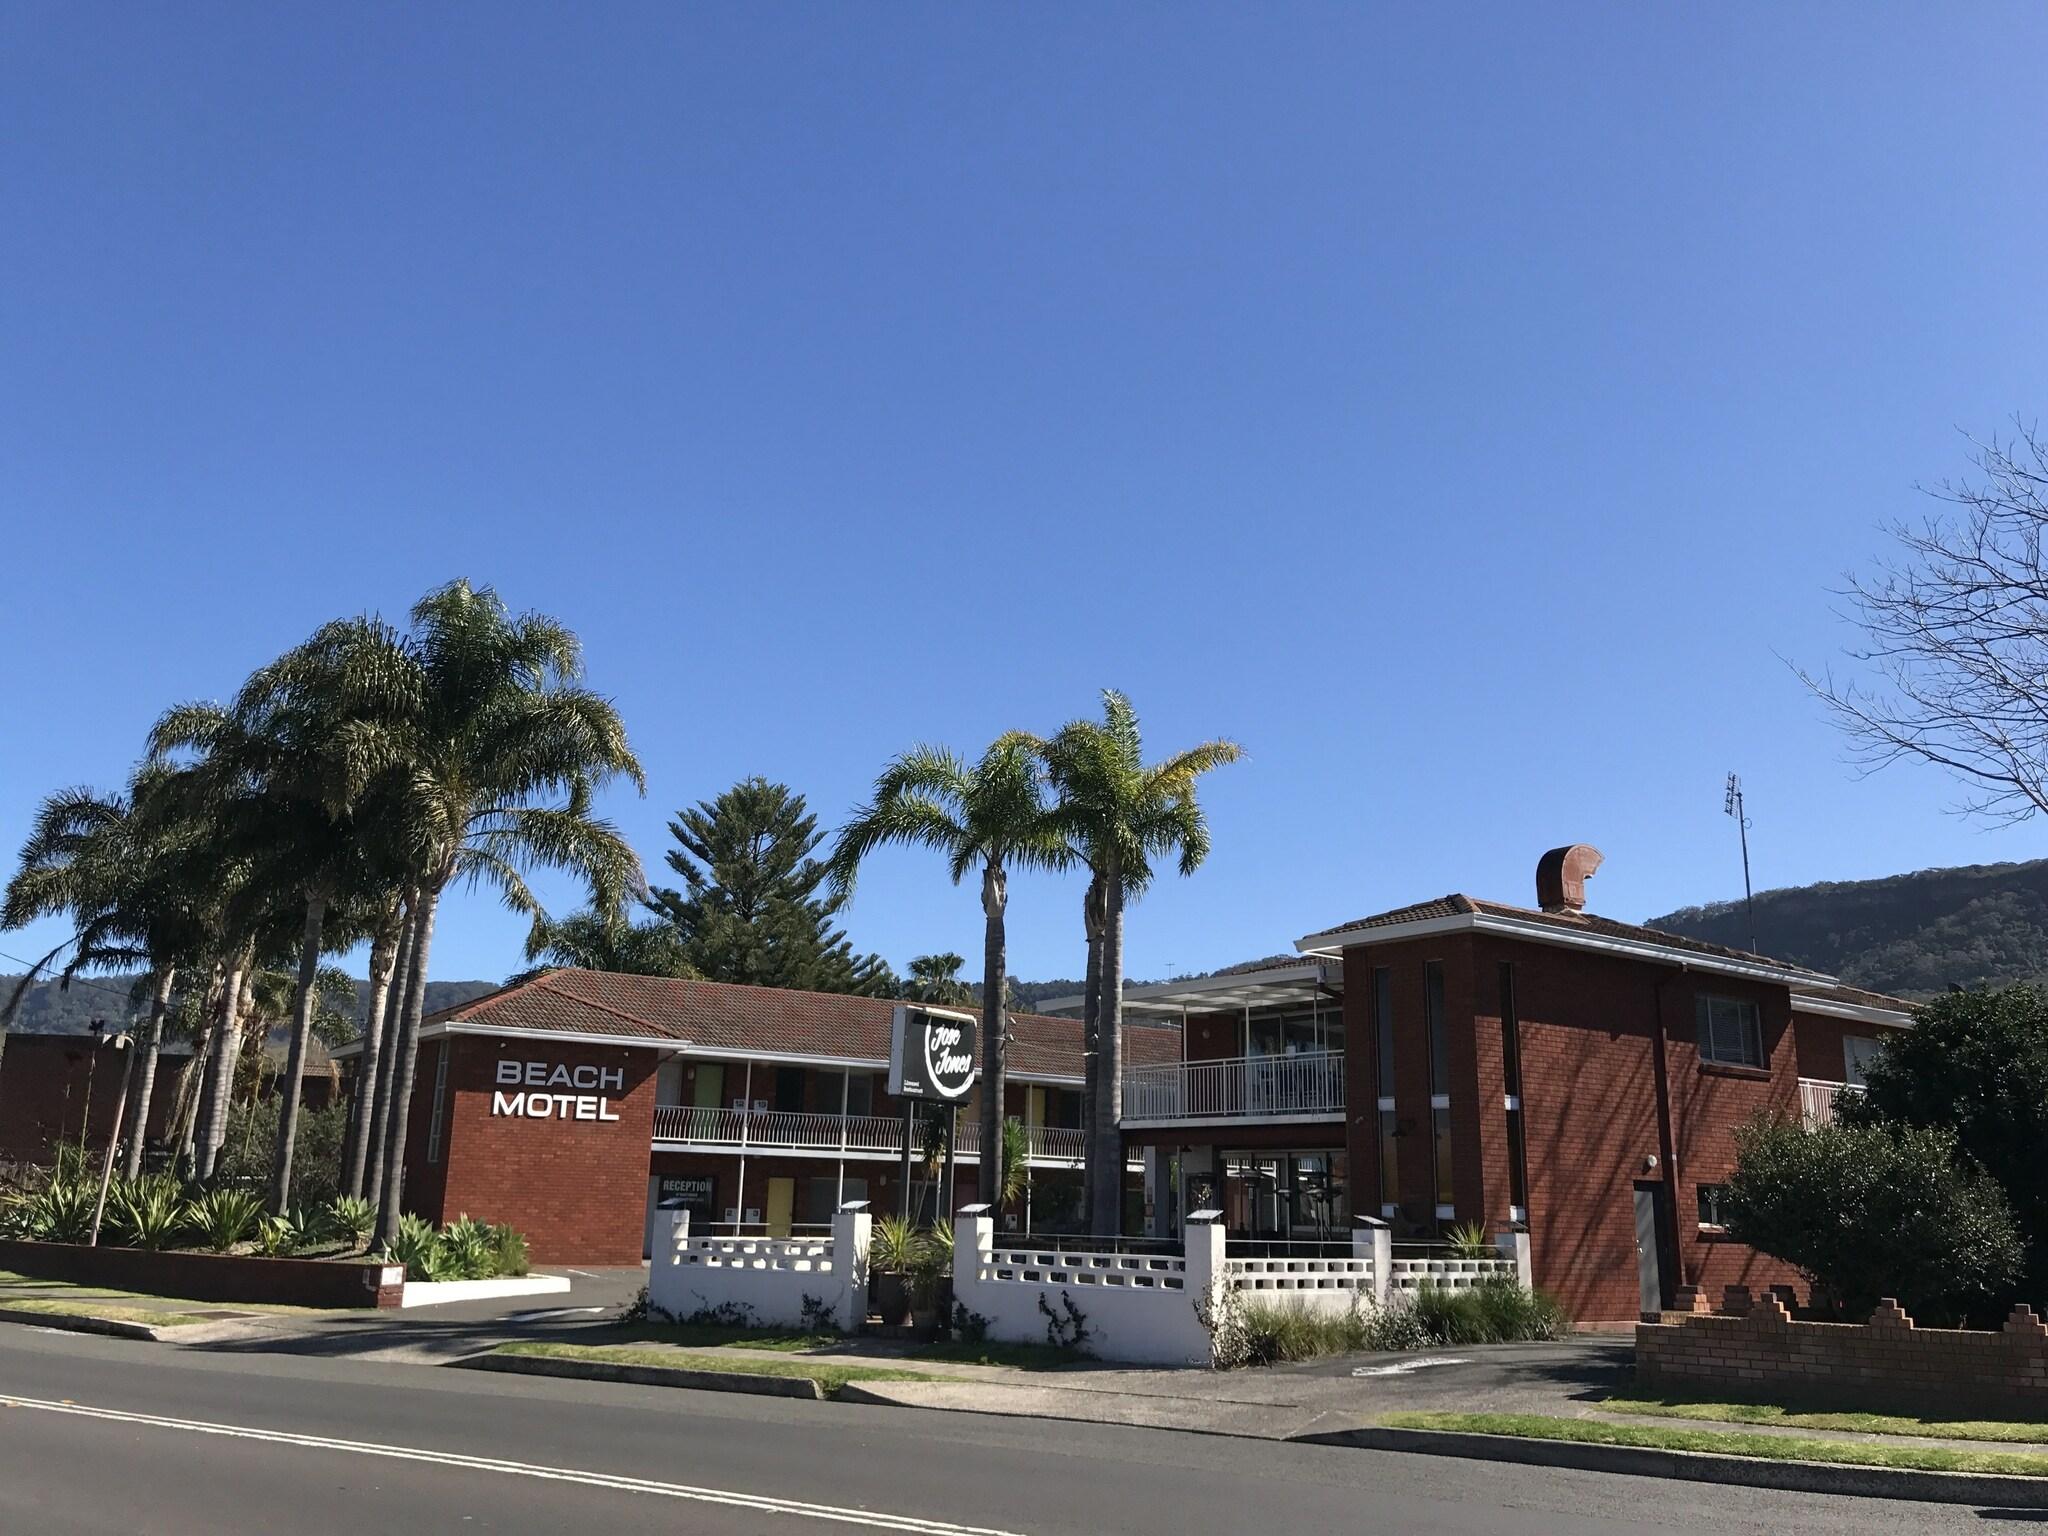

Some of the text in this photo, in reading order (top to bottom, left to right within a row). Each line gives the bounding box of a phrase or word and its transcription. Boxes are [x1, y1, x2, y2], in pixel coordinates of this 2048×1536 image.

[496, 1060, 623, 1090] BEACH
[935, 1047, 972, 1075] Jones
[492, 1091, 620, 1120] MOTEL
[663, 1180, 712, 1192] RECEPTION
